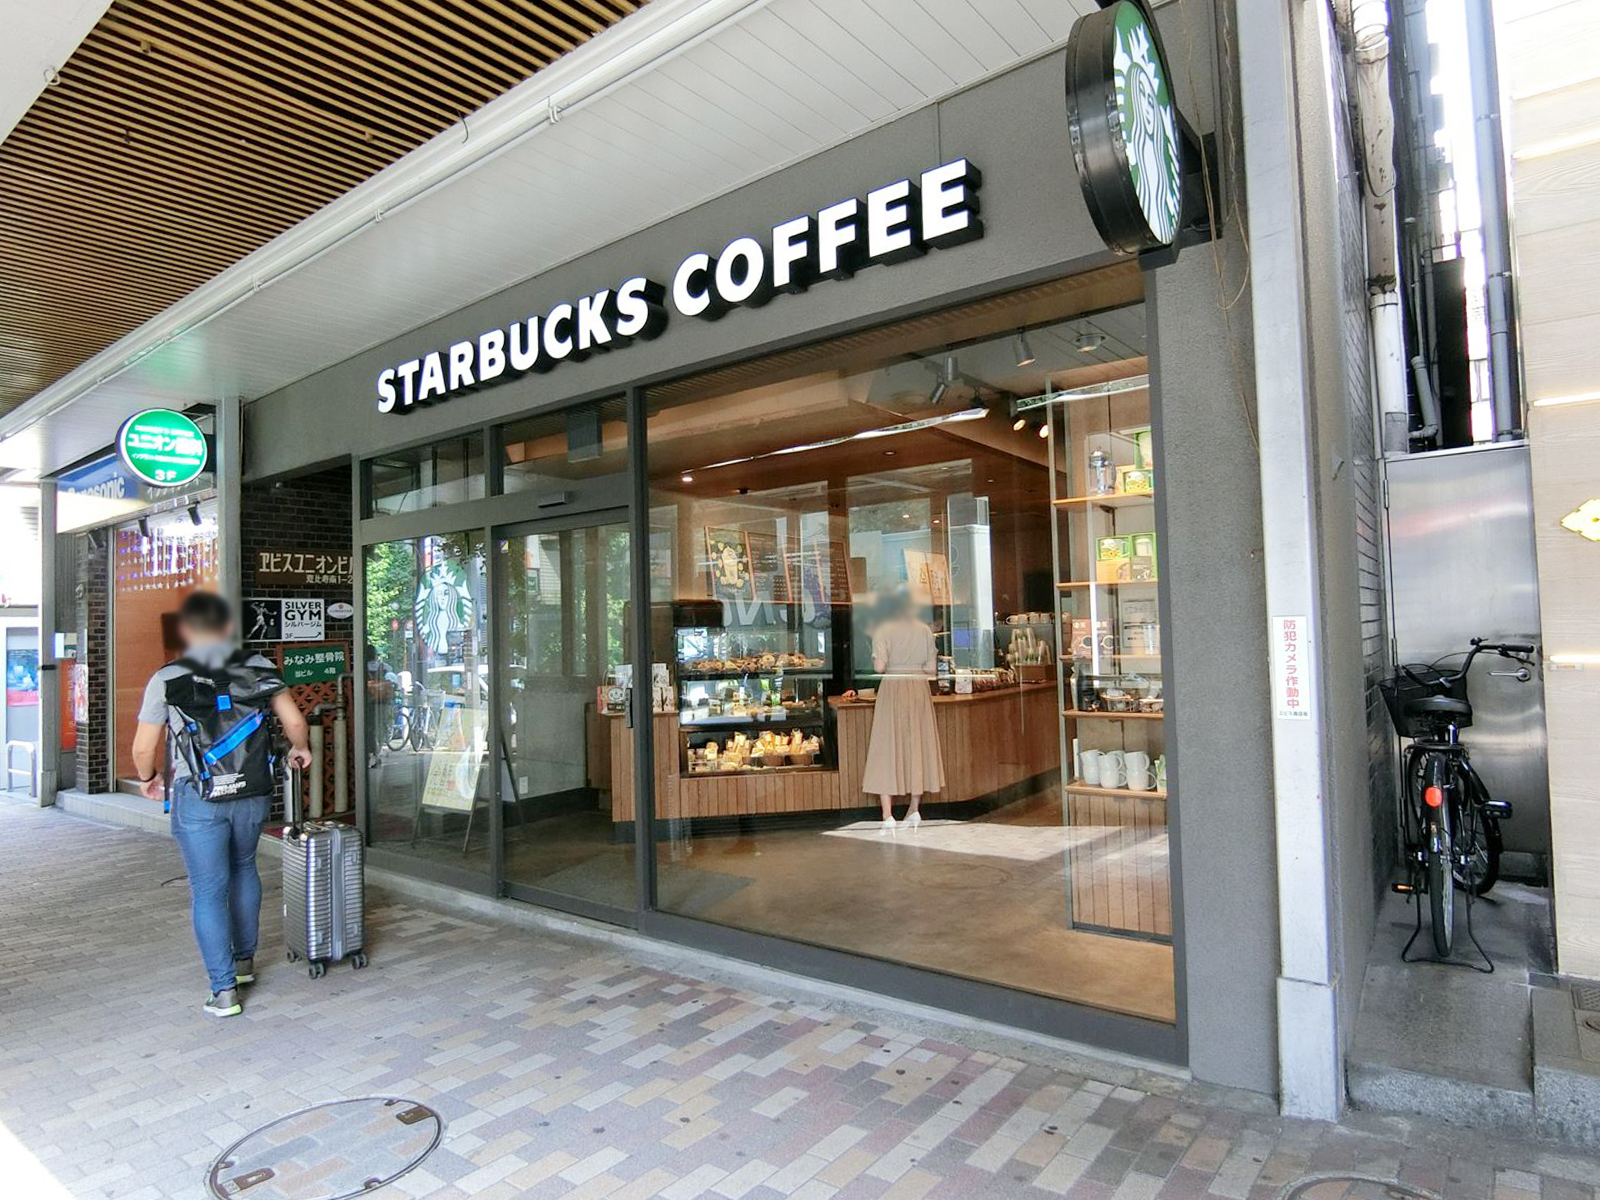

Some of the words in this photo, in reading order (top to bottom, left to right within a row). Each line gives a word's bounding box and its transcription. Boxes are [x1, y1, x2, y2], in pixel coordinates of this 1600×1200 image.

[376, 277, 649, 414] STARBUCKS
[671, 158, 970, 317] COFFEE
[127, 432, 203, 456] ユニオン
[155, 469, 177, 480] 3F
[67, 471, 126, 499] asonic
[284, 609, 322, 620] GYM
[285, 601, 322, 609] SILVER
[283, 651, 345, 666] みなみ整骨院
[1283, 619, 1300, 709] 防犯カメラ作動中
